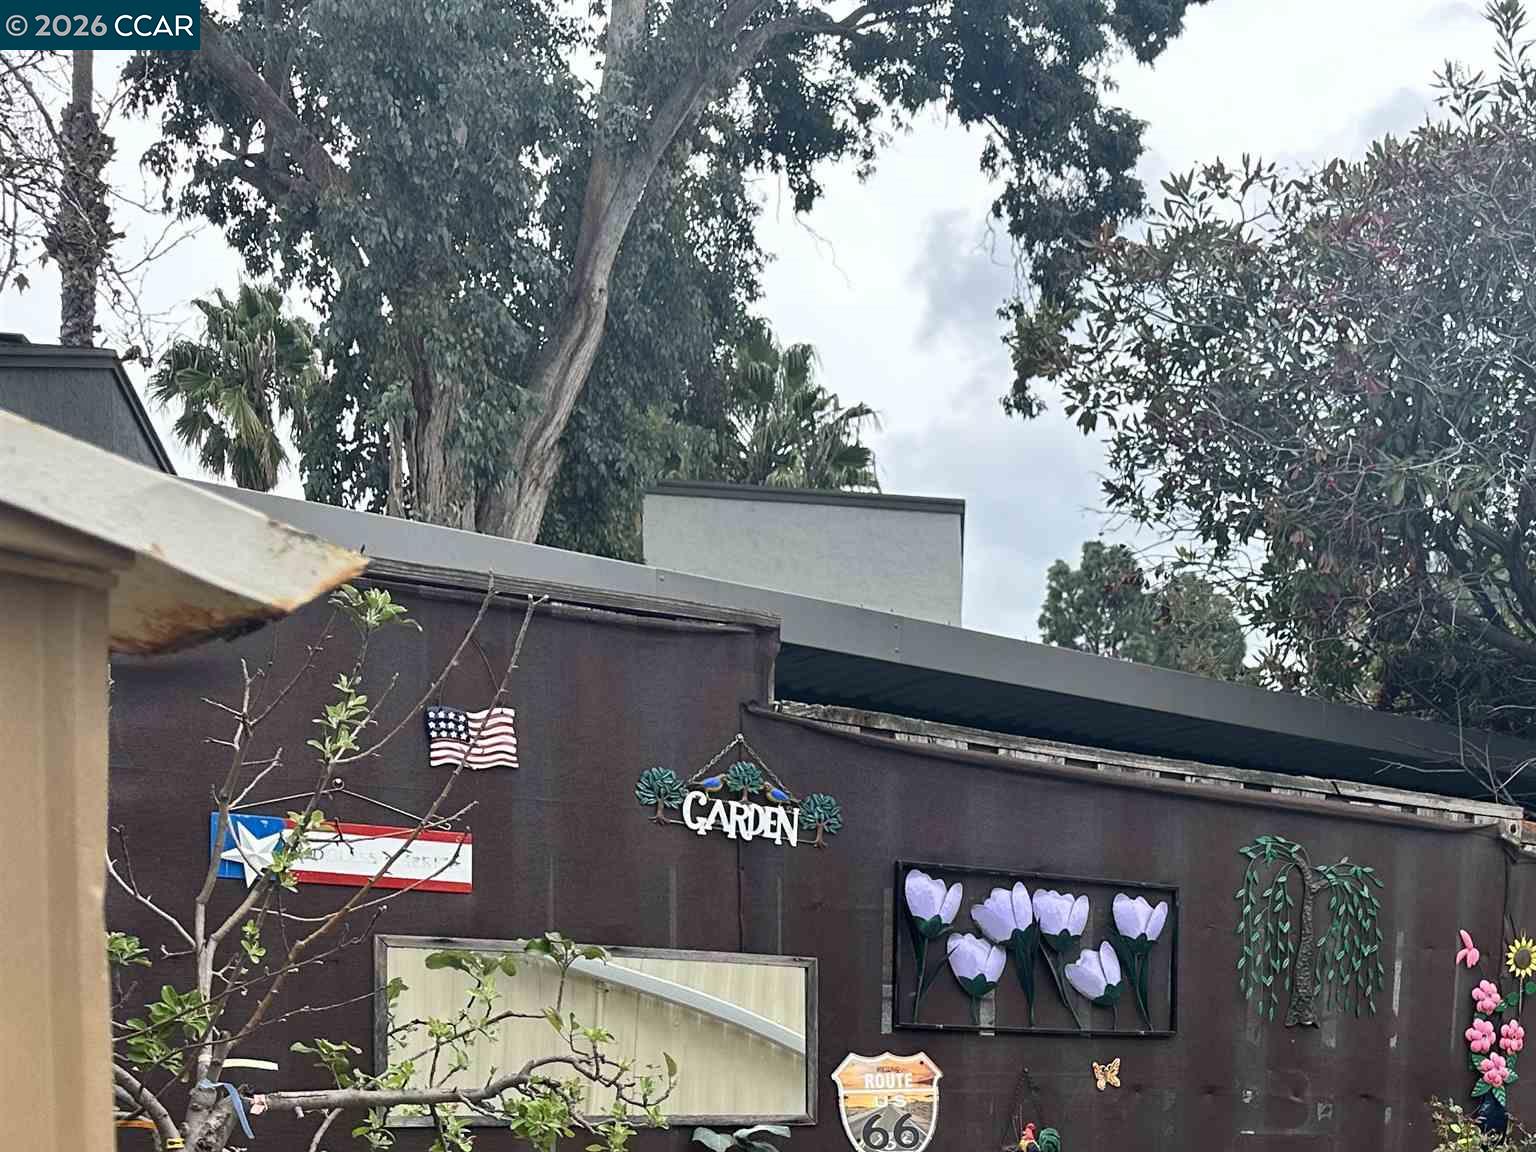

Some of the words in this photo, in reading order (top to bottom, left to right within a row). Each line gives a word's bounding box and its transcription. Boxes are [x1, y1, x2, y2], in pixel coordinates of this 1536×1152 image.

[682, 790, 799, 847] GARDEN
[864, 1072, 912, 1089] ROUTE
[862, 1113, 920, 1150] 66
